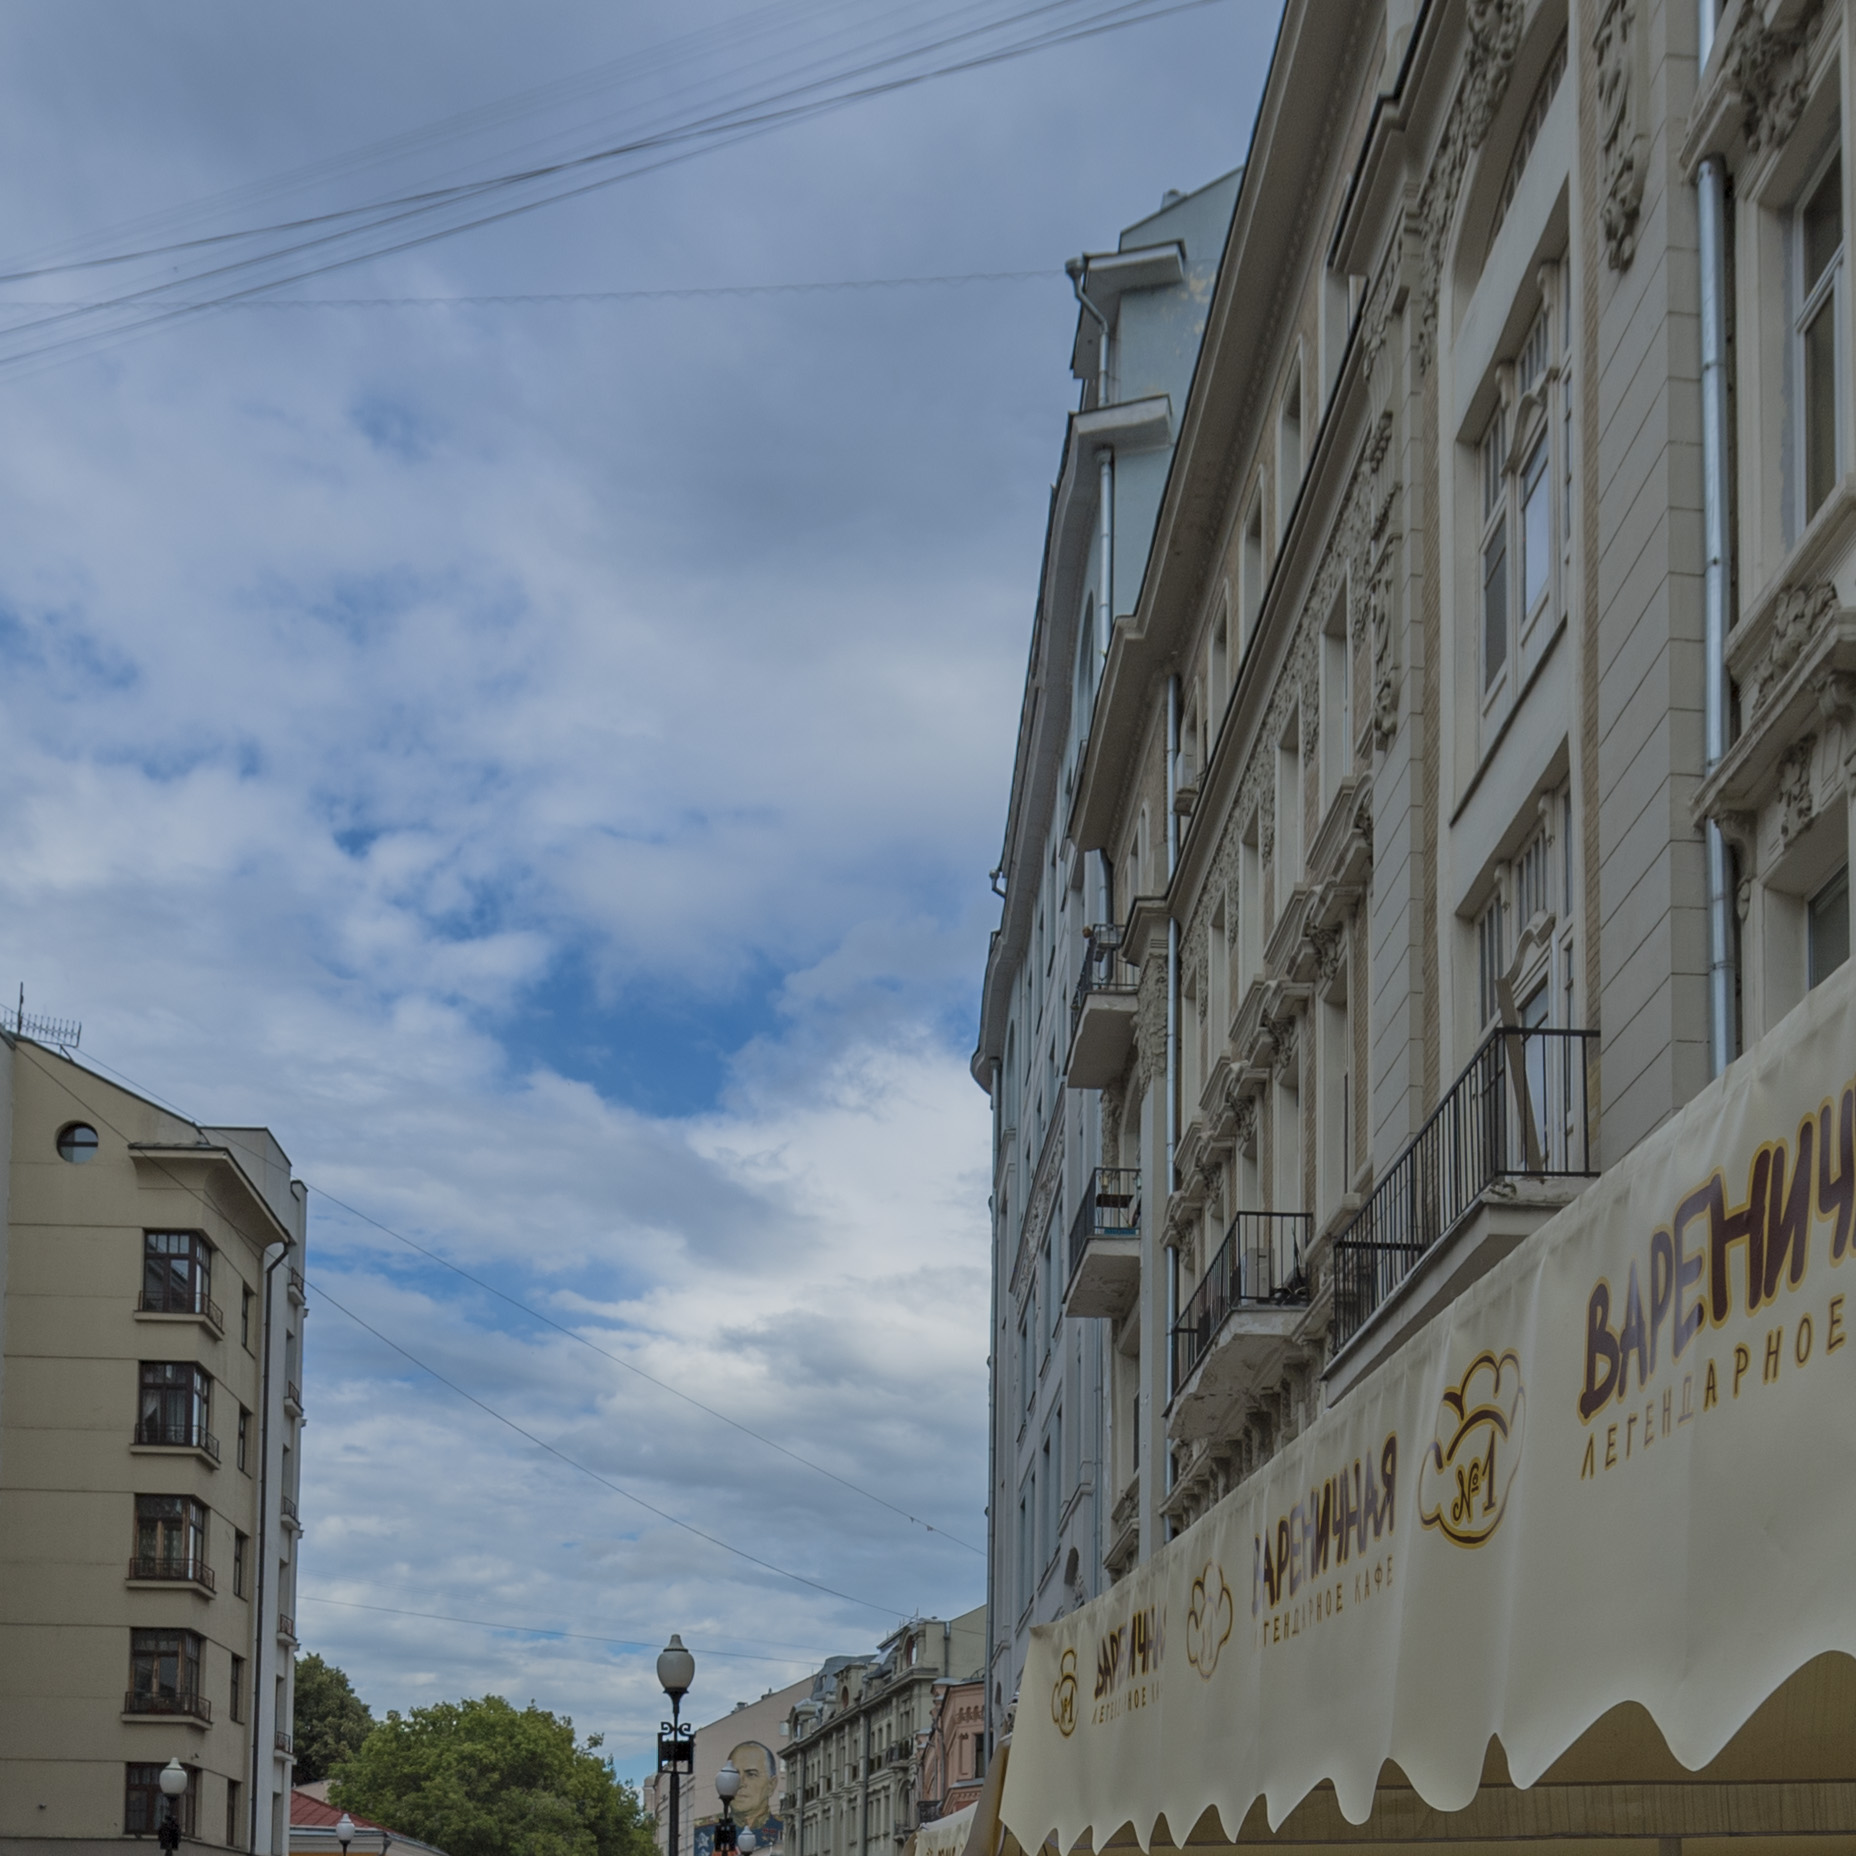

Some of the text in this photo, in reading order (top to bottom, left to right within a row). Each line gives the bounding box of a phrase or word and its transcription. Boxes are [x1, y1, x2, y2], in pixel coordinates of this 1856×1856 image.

[1579, 1292, 1848, 1481] ЛЕГЕНДАРНОЕ
[1451, 1428, 1498, 1524] №1
[1256, 1553, 1394, 1650] ГЕНДАРНОЕ КАФЕ
